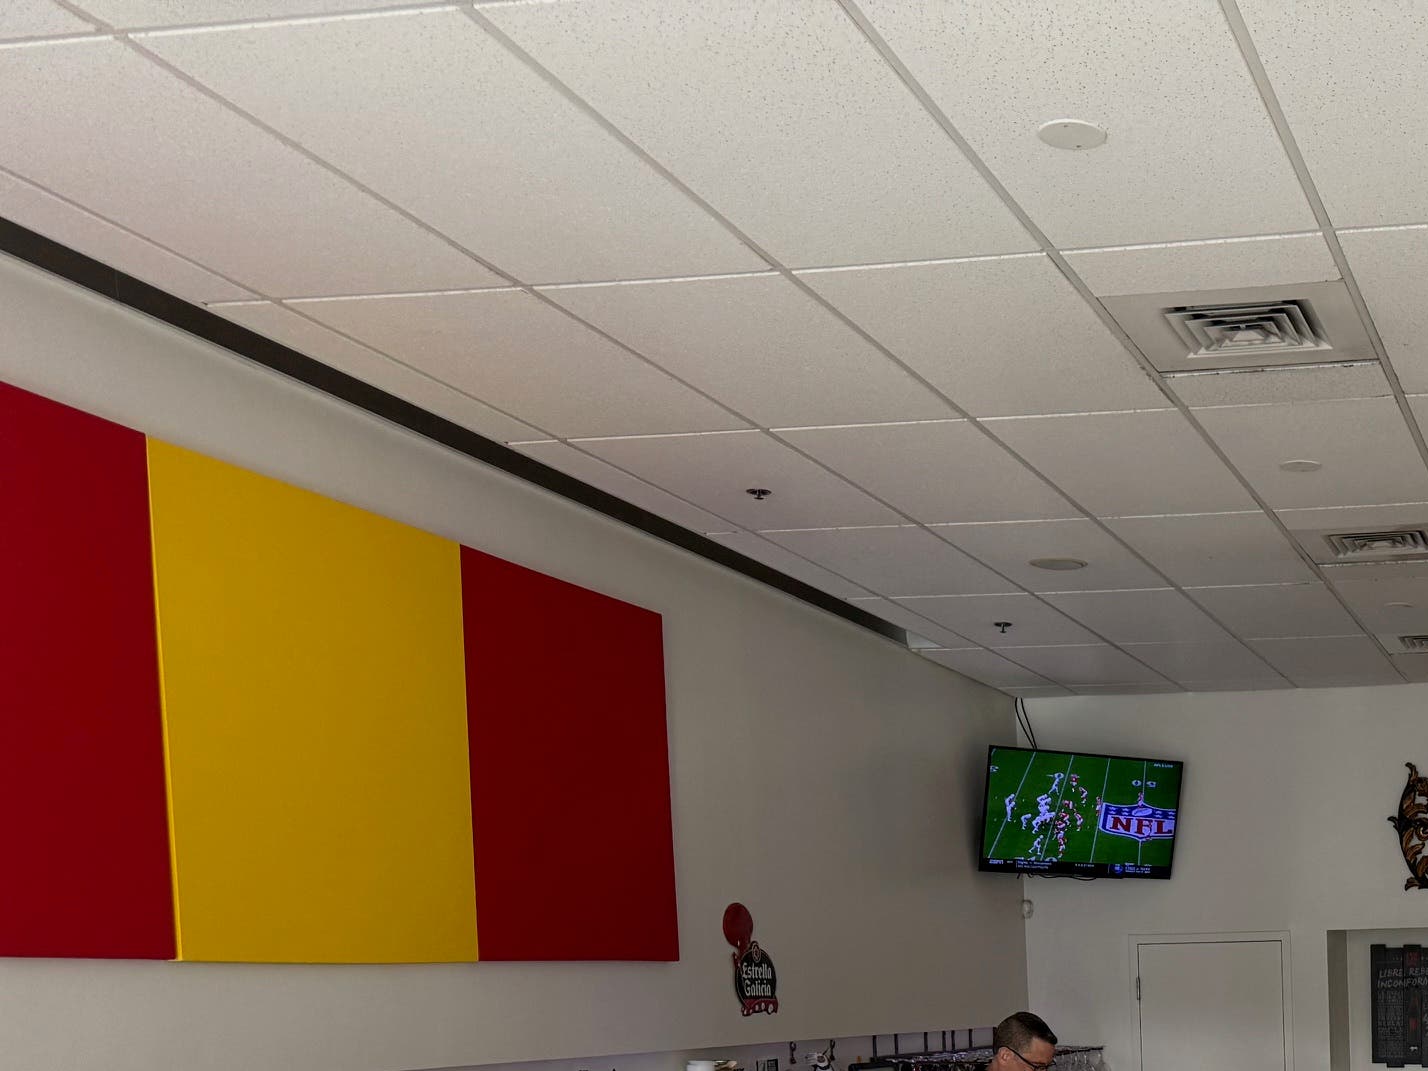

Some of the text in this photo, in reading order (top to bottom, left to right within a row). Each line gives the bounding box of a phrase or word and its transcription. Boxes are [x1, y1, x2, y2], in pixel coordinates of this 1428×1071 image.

[1110, 815, 1173, 835] NFL
[742, 962, 772, 979] Estrella
[744, 980, 771, 996] Galicia
